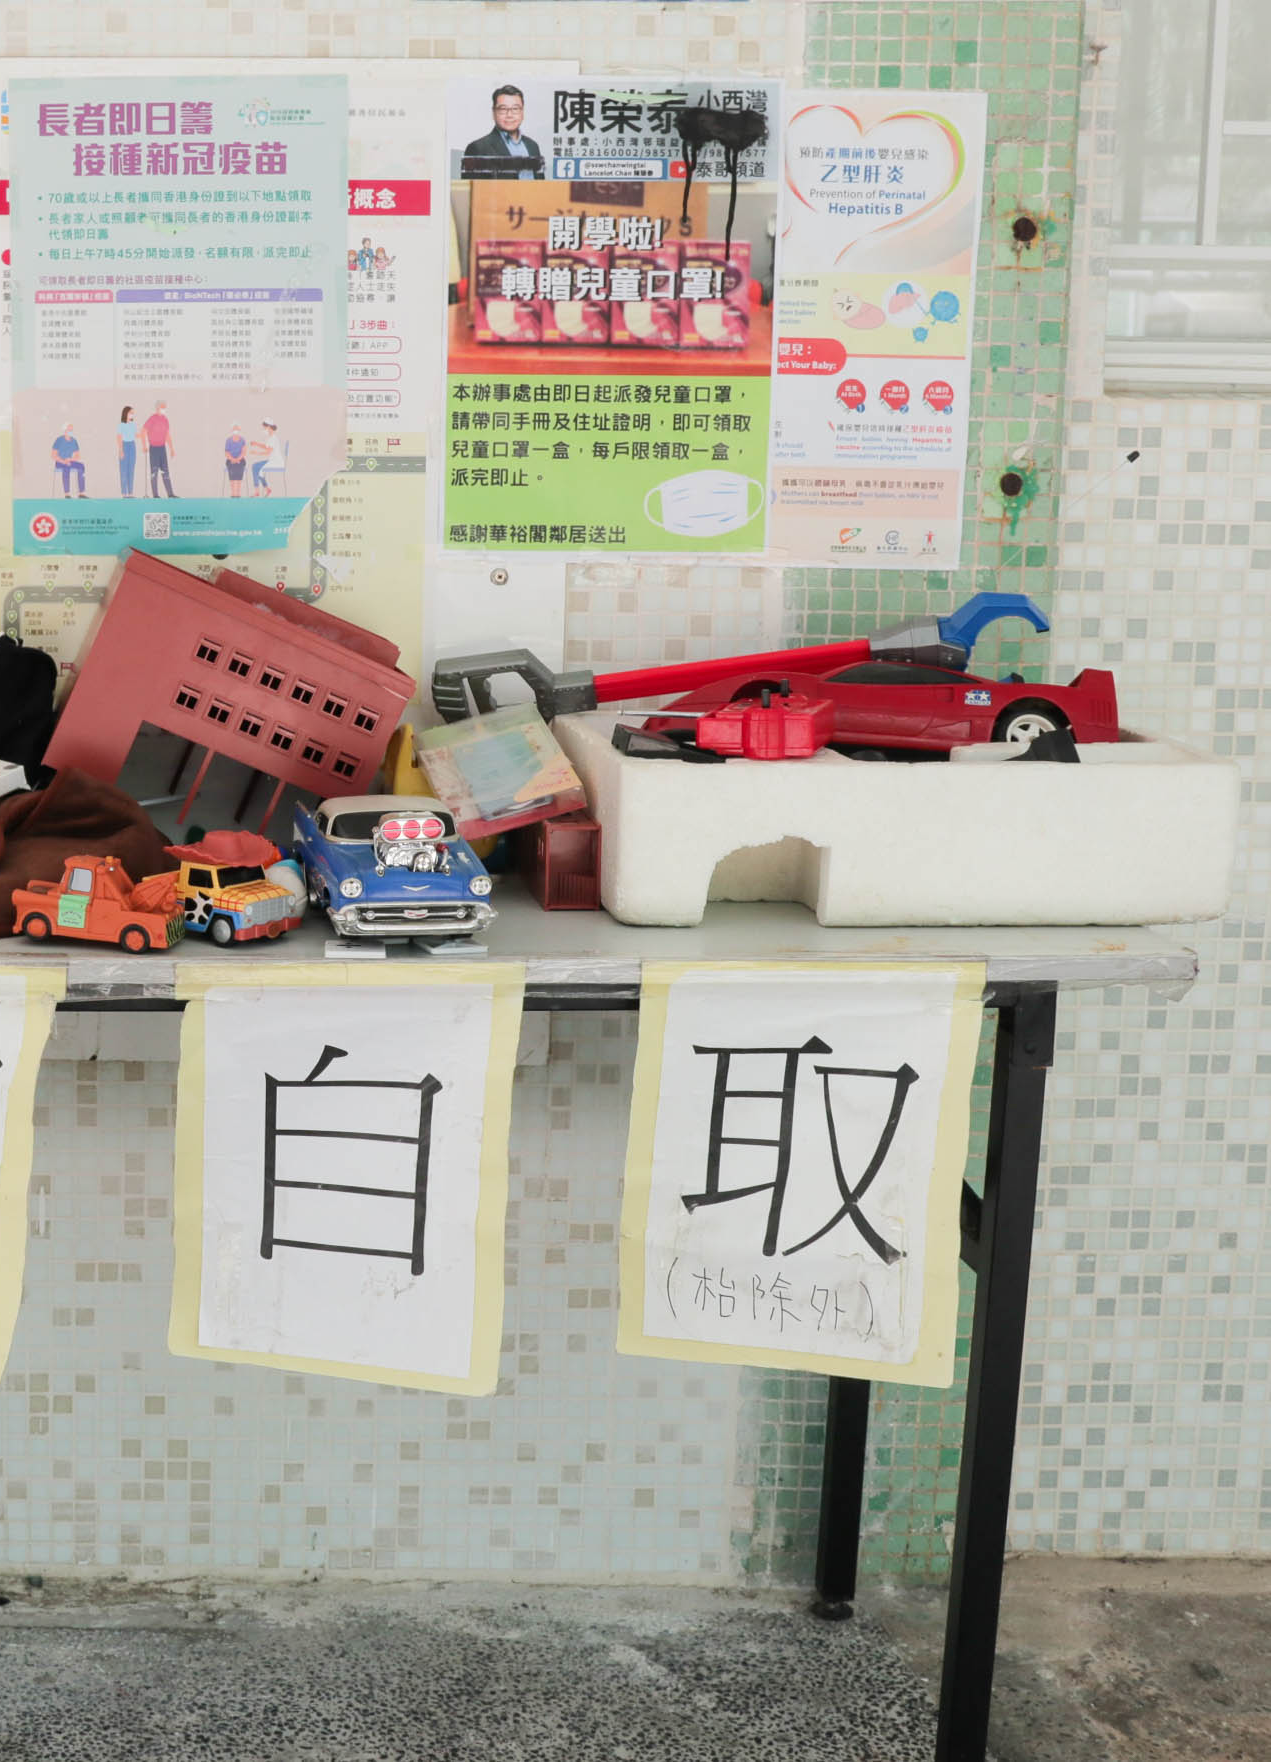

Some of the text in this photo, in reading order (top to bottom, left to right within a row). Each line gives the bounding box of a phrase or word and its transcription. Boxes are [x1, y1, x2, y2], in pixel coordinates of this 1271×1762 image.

[698, 89, 767, 113] 小西灣
[38, 101, 213, 136] 長者即日籌
[73, 141, 288, 177] 接種新冠疫苗
[820, 164, 905, 184] 乙型肝炎
[809, 189, 926, 200] Prevention of Perinatal
[828, 203, 903, 216] Hepatitis B
[548, 215, 662, 251] 開學啦！
[500, 267, 726, 302] 轉贈兒童口罩！
[452, 383, 746, 405] 本辦事處由即日起派發兒童口罩，
[451, 411, 751, 433] 請帶同手冊及住址證明，即可領取
[451, 440, 743, 461] 兒童口罩一盒，每戶限領取一盒，
[451, 468, 544, 487] 派完即止。
[449, 524, 627, 545] 感謝華裕閣鄰居送出
[260, 1044, 443, 1276] 自
[681, 1035, 920, 1266] 取
[667, 1256, 874, 1343] (枱除外)
